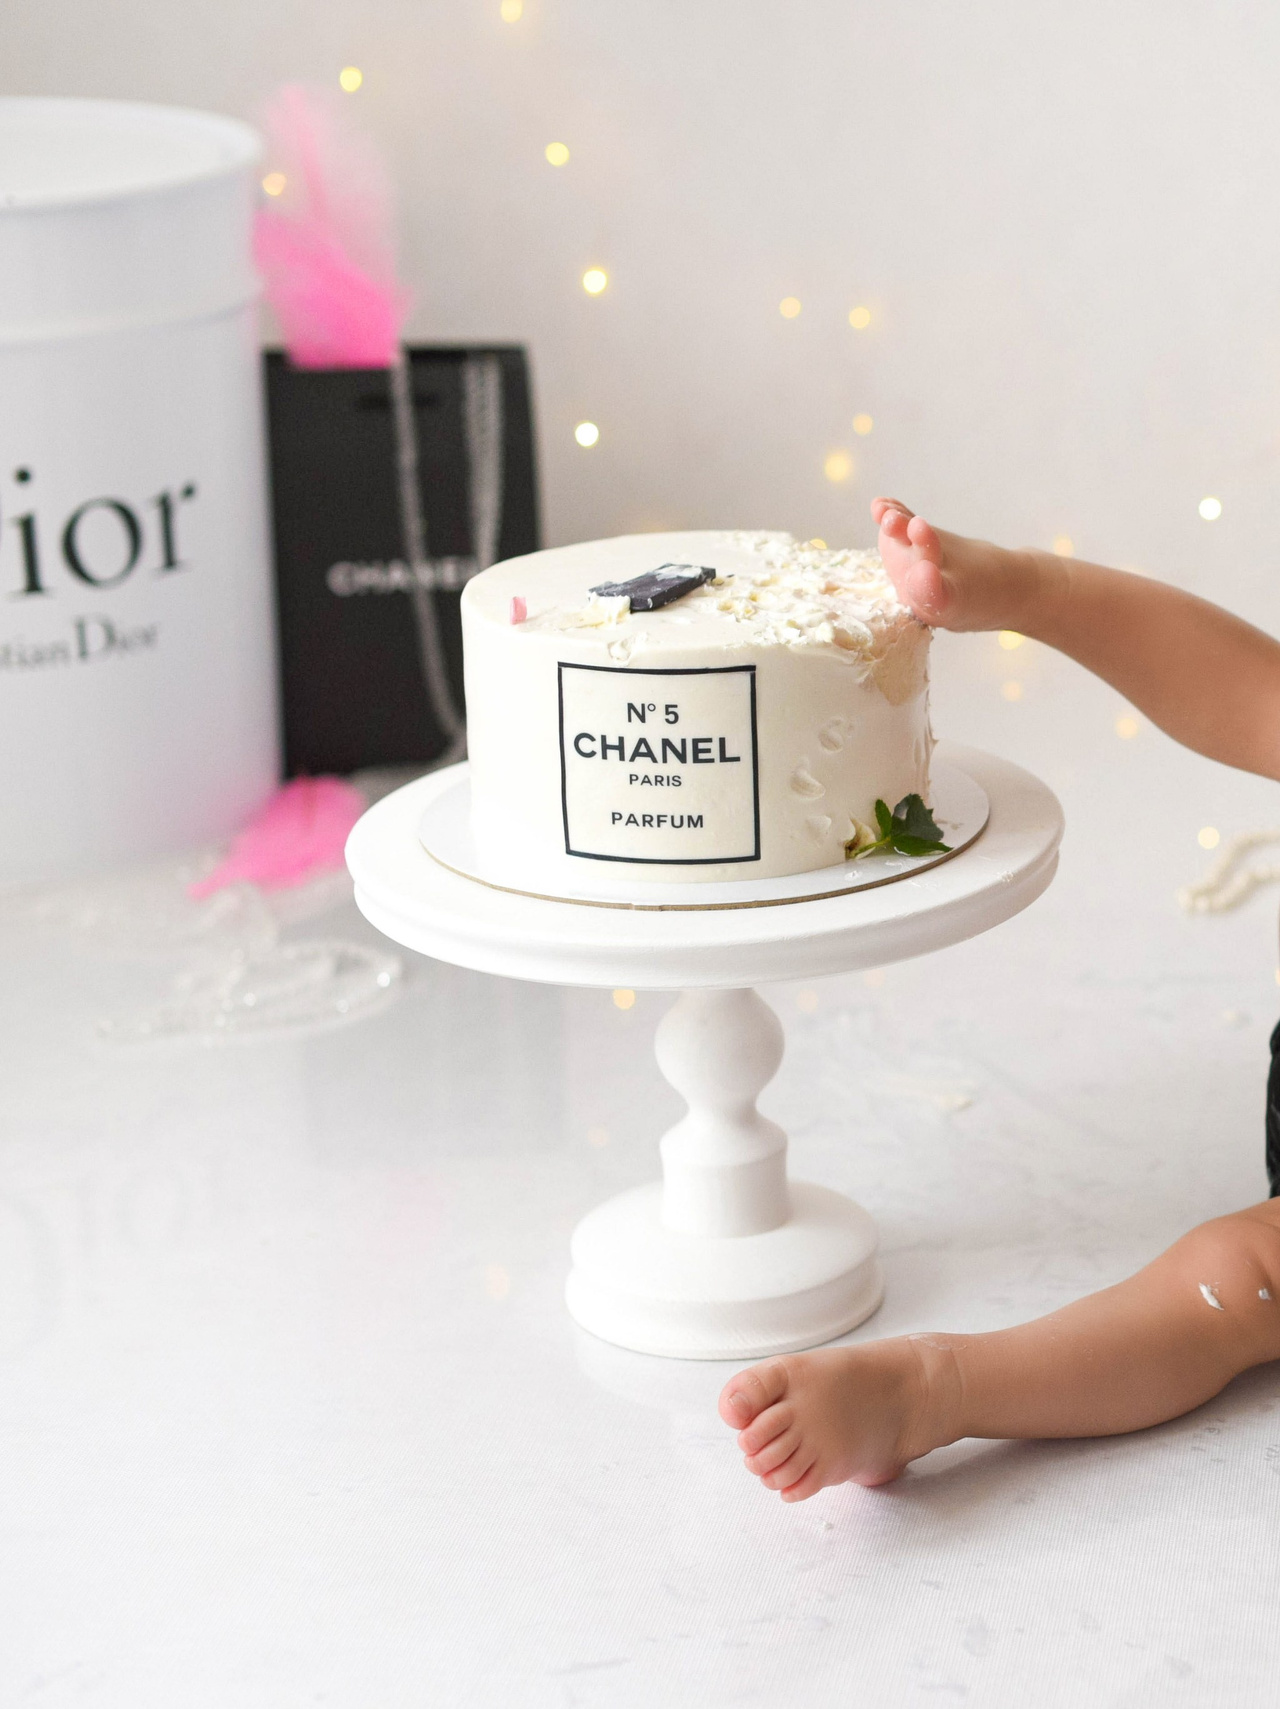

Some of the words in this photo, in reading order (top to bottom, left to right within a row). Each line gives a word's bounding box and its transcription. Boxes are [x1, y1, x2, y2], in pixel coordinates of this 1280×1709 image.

[0, 464, 197, 598] ior
[325, 557, 482, 597] CHAE
[664, 704, 680, 725] 5
[573, 732, 741, 764] CHANEL
[629, 773, 682, 787] PARIS
[611, 811, 704, 829] PARFUM
